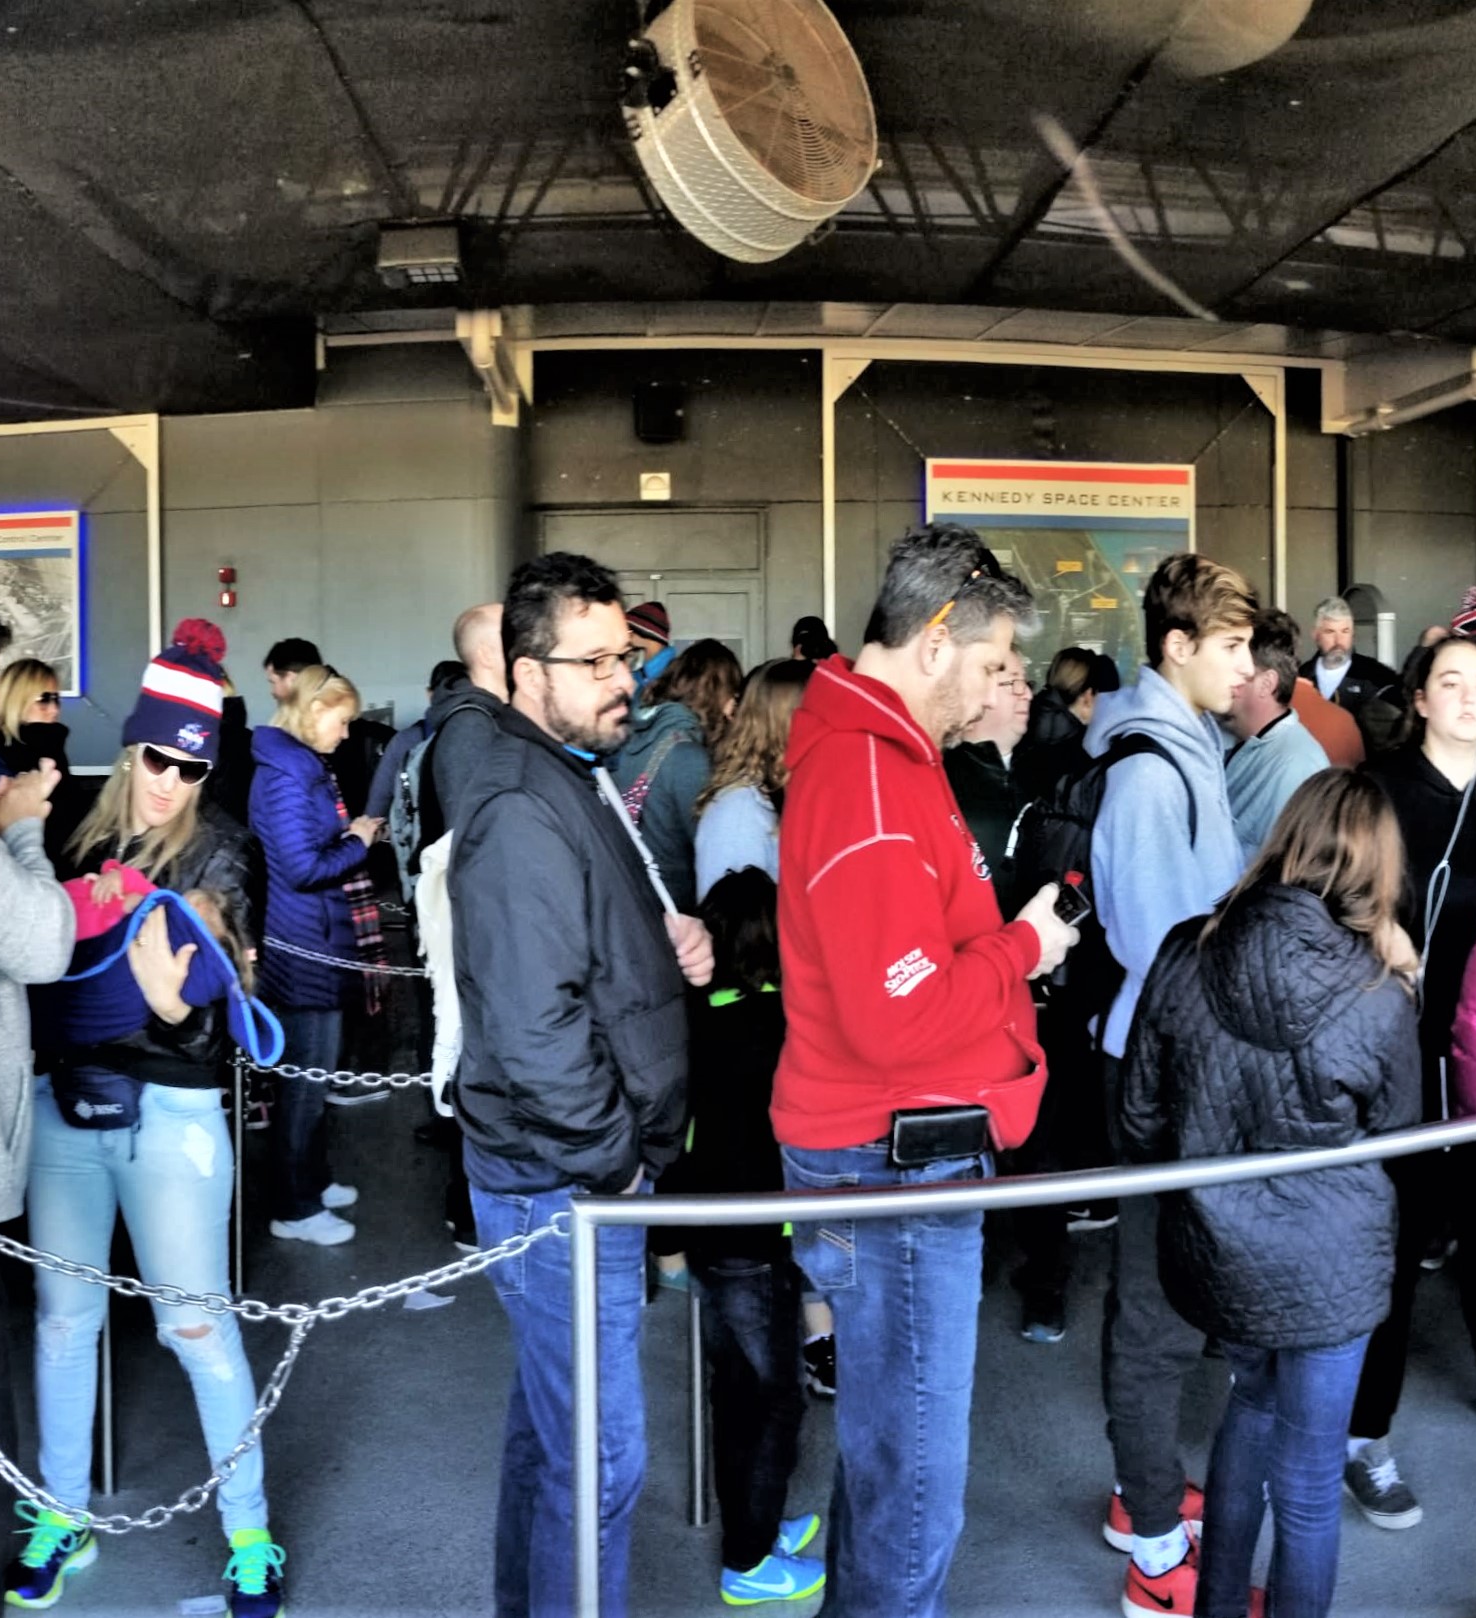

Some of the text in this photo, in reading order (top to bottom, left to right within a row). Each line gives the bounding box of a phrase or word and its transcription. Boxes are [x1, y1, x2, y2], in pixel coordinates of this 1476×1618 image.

[941, 491, 1181, 508] KENNEDY SPACE CENTER
